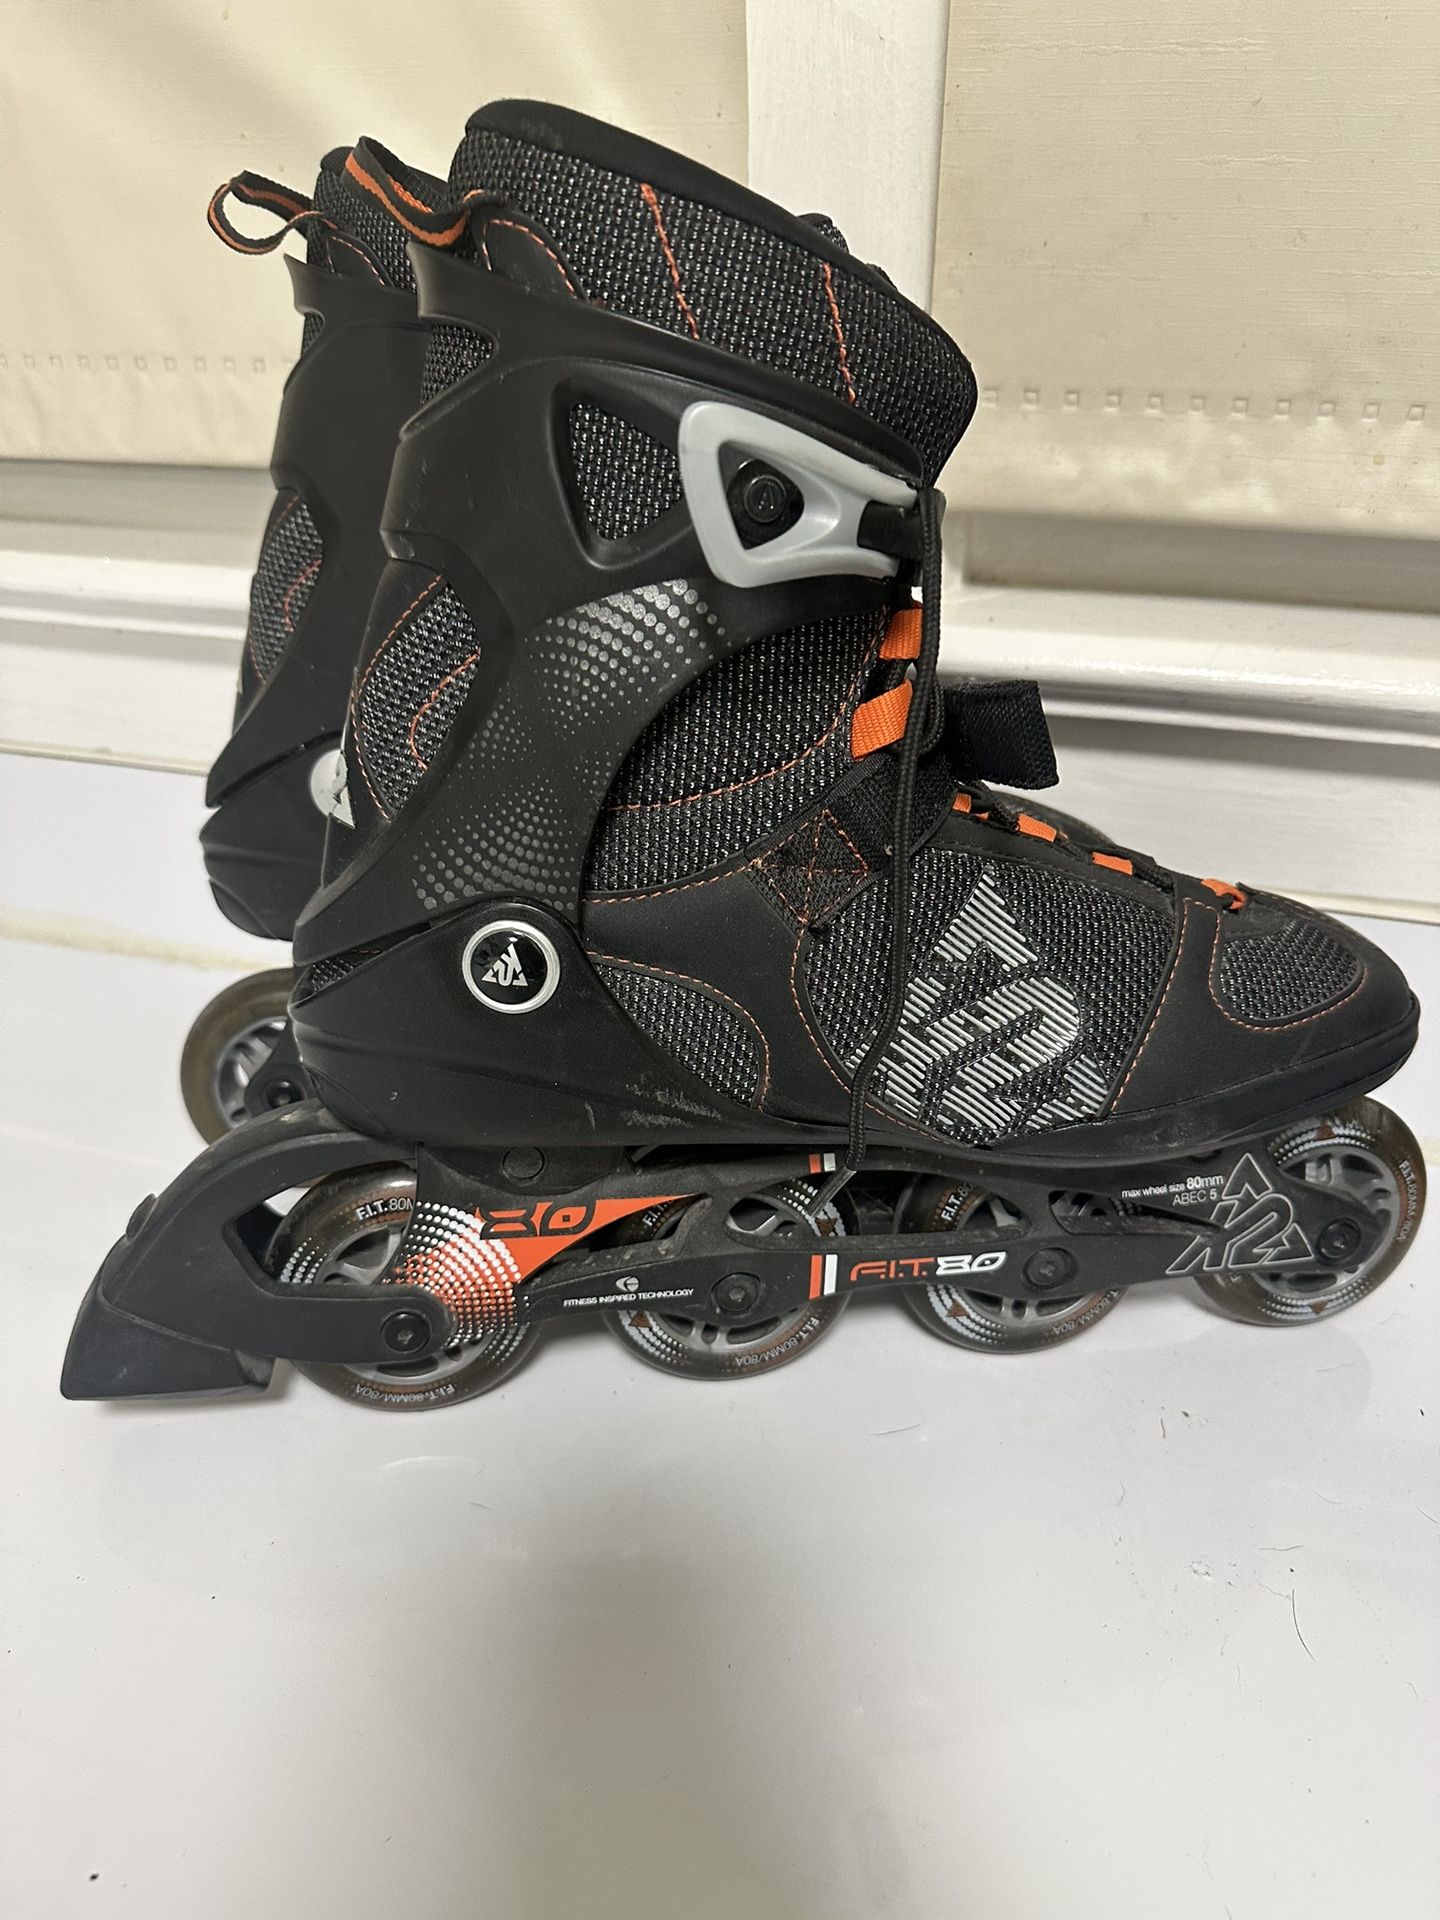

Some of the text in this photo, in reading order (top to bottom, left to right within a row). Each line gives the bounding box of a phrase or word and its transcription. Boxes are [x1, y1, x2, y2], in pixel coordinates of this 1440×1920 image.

[1121, 1175, 1224, 1198] max wheel size 80mm
[1172, 1188, 1217, 1206] ABEC 5
[563, 1288, 694, 1307] FITNESS INSPIRED TECHNOLOGY
